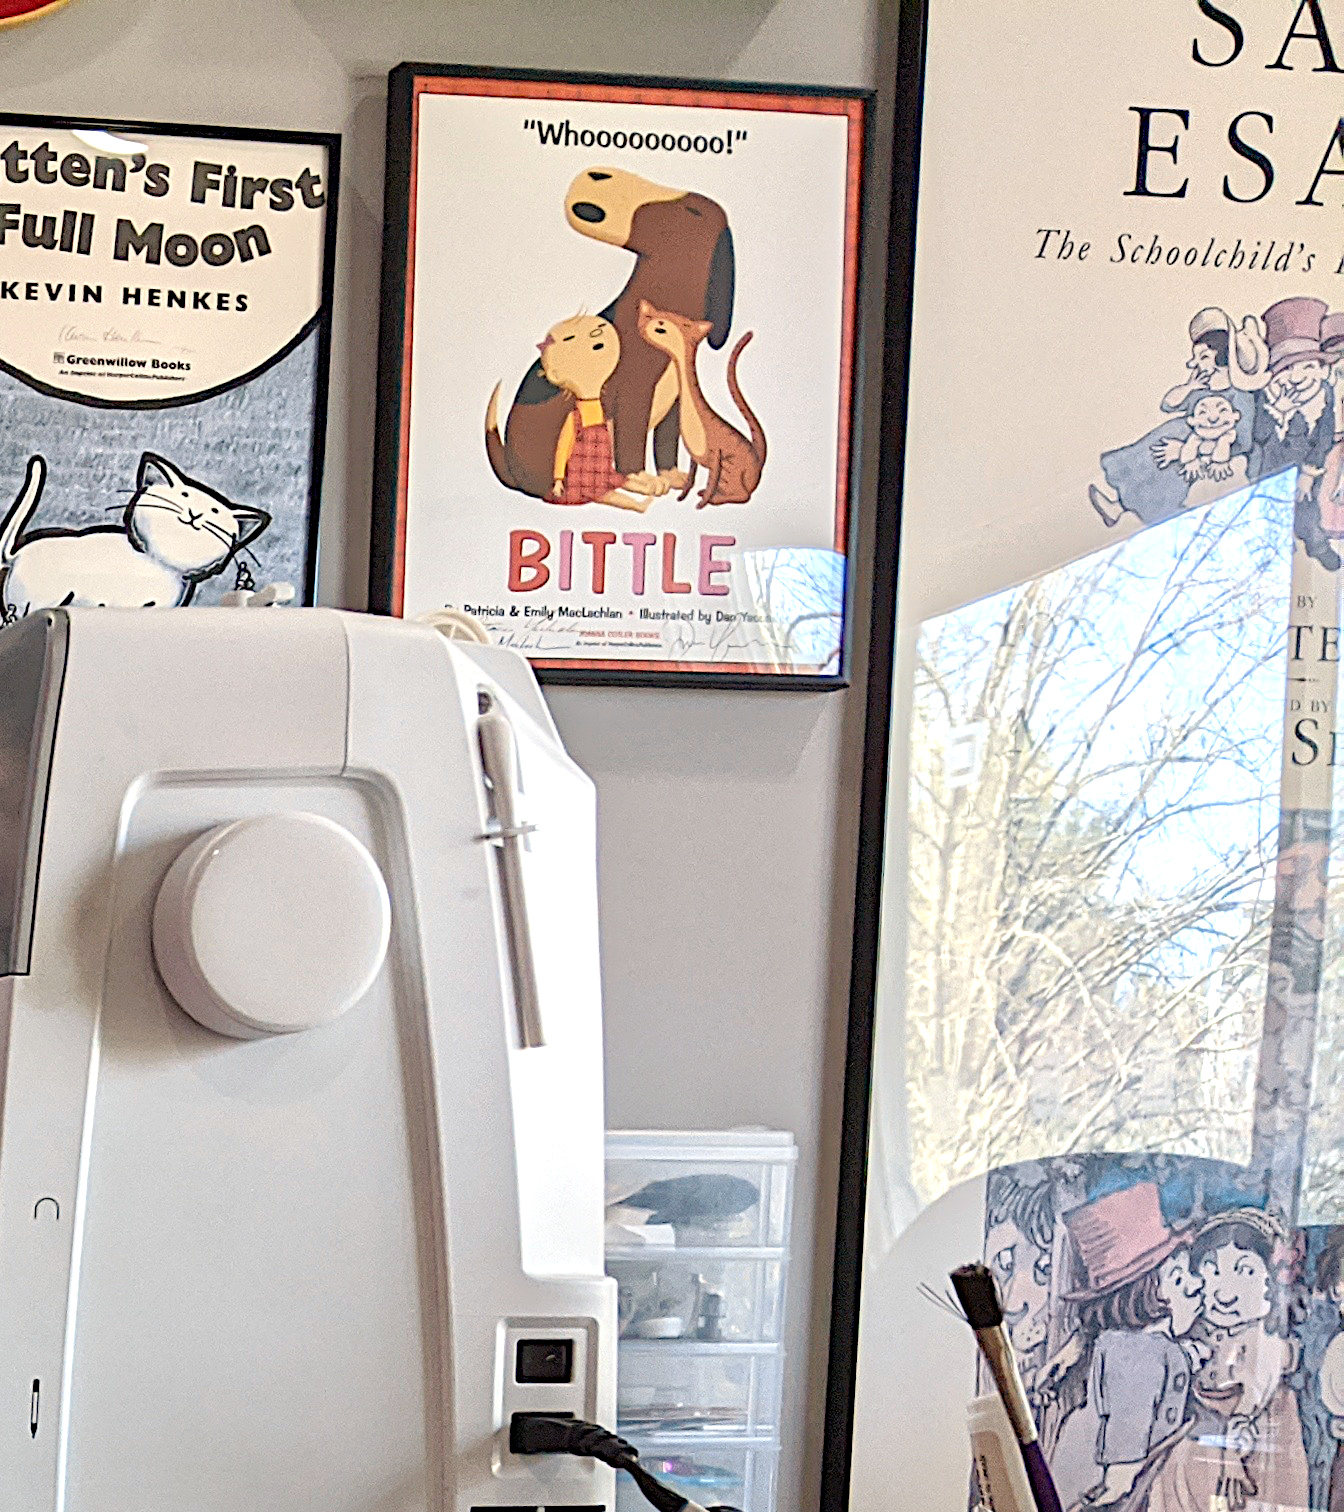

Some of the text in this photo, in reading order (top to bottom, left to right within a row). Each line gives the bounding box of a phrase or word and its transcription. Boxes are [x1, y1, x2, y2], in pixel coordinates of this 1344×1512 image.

[190, 160, 326, 212] First
[113, 218, 272, 268] Moon
[1035, 229, 1091, 261] The
[1110, 233, 1316, 273] Schoolchild's
[0, 280, 250, 313] KEVIN HENKES
[66, 354, 192, 371] Greenwillow Books
[507, 529, 737, 596] BITTLE
[463, 604, 505, 618] Patricia
[509, 604, 520, 618] &
[524, 605, 554, 621] Emily
[558, 606, 623, 619] MacLachlan
[639, 608, 695, 621] Illustrated
[698, 610, 712, 625] by
